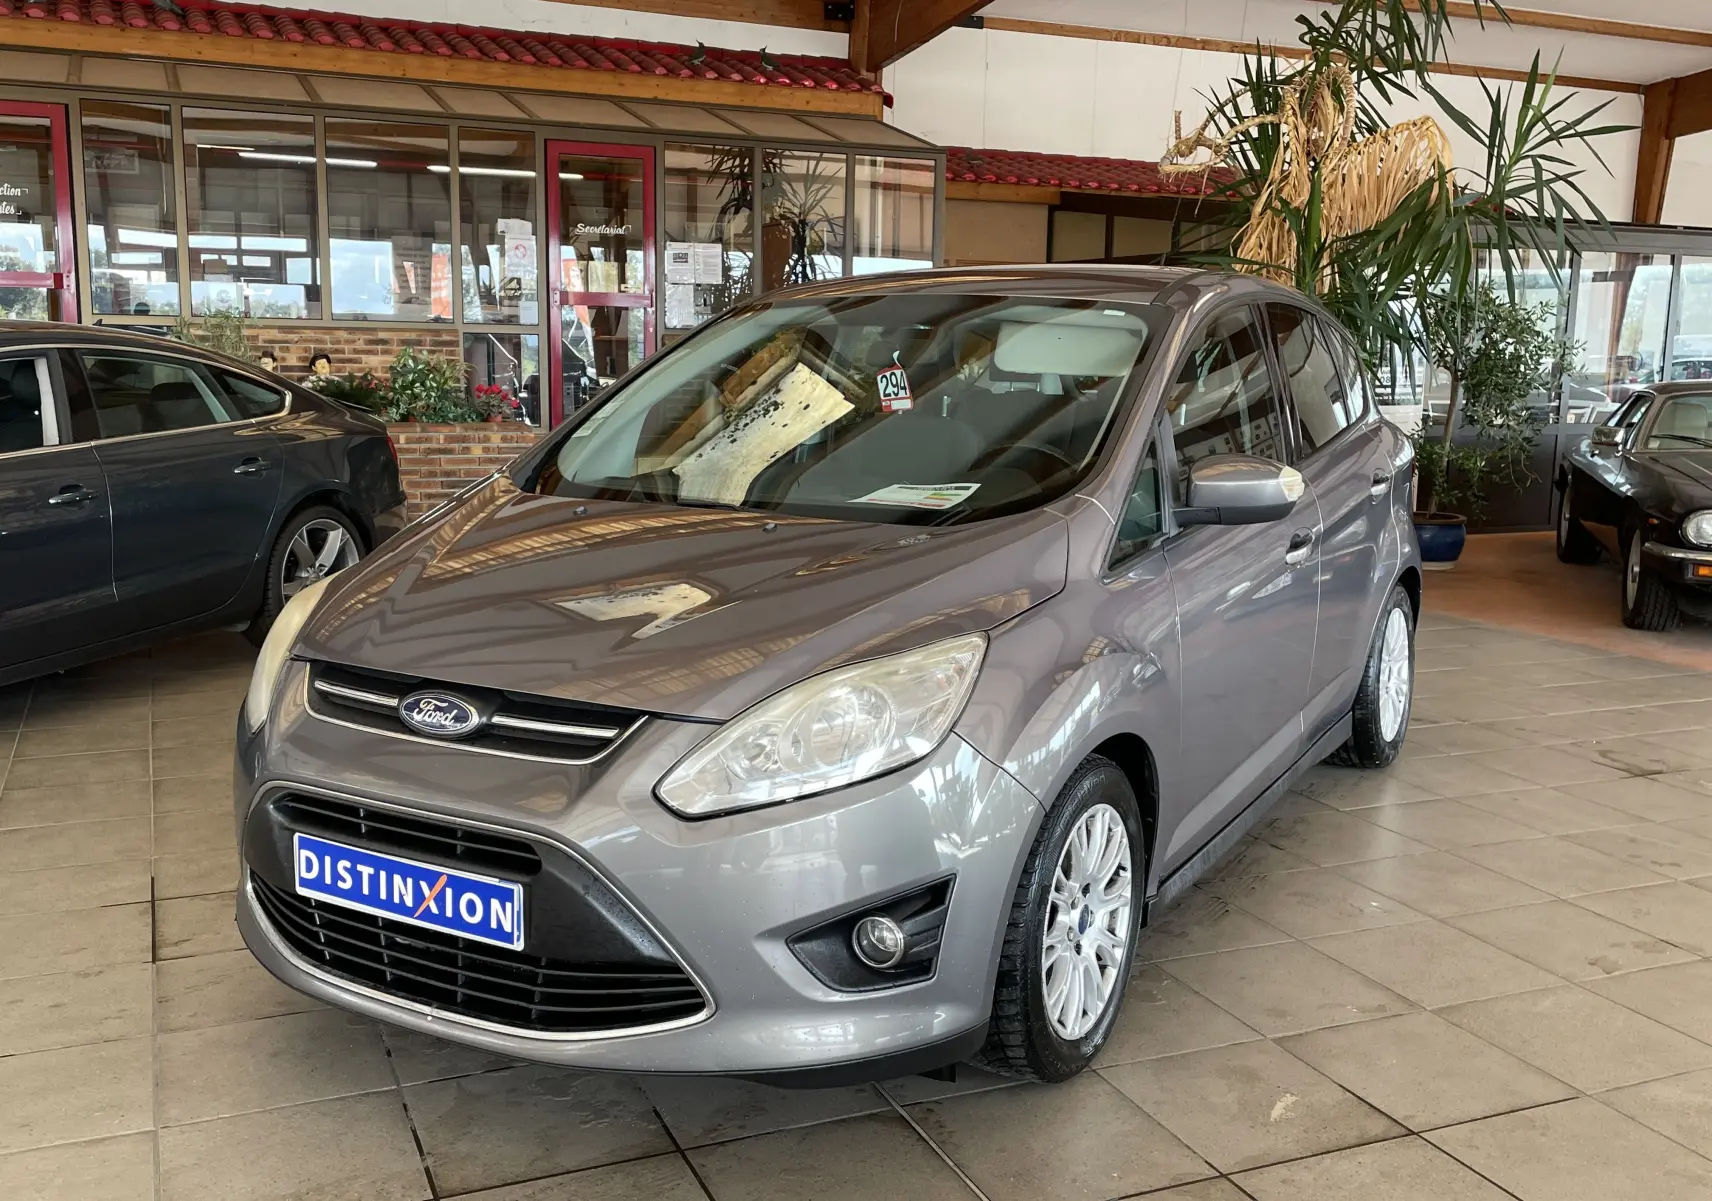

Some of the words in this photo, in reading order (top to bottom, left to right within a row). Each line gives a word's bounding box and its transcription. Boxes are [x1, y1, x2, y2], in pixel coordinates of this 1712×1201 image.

[575, 222, 627, 236] Secretariat
[880, 370, 907, 397] 294
[413, 698, 458, 726] Ford
[299, 848, 512, 933] DISTINXION
